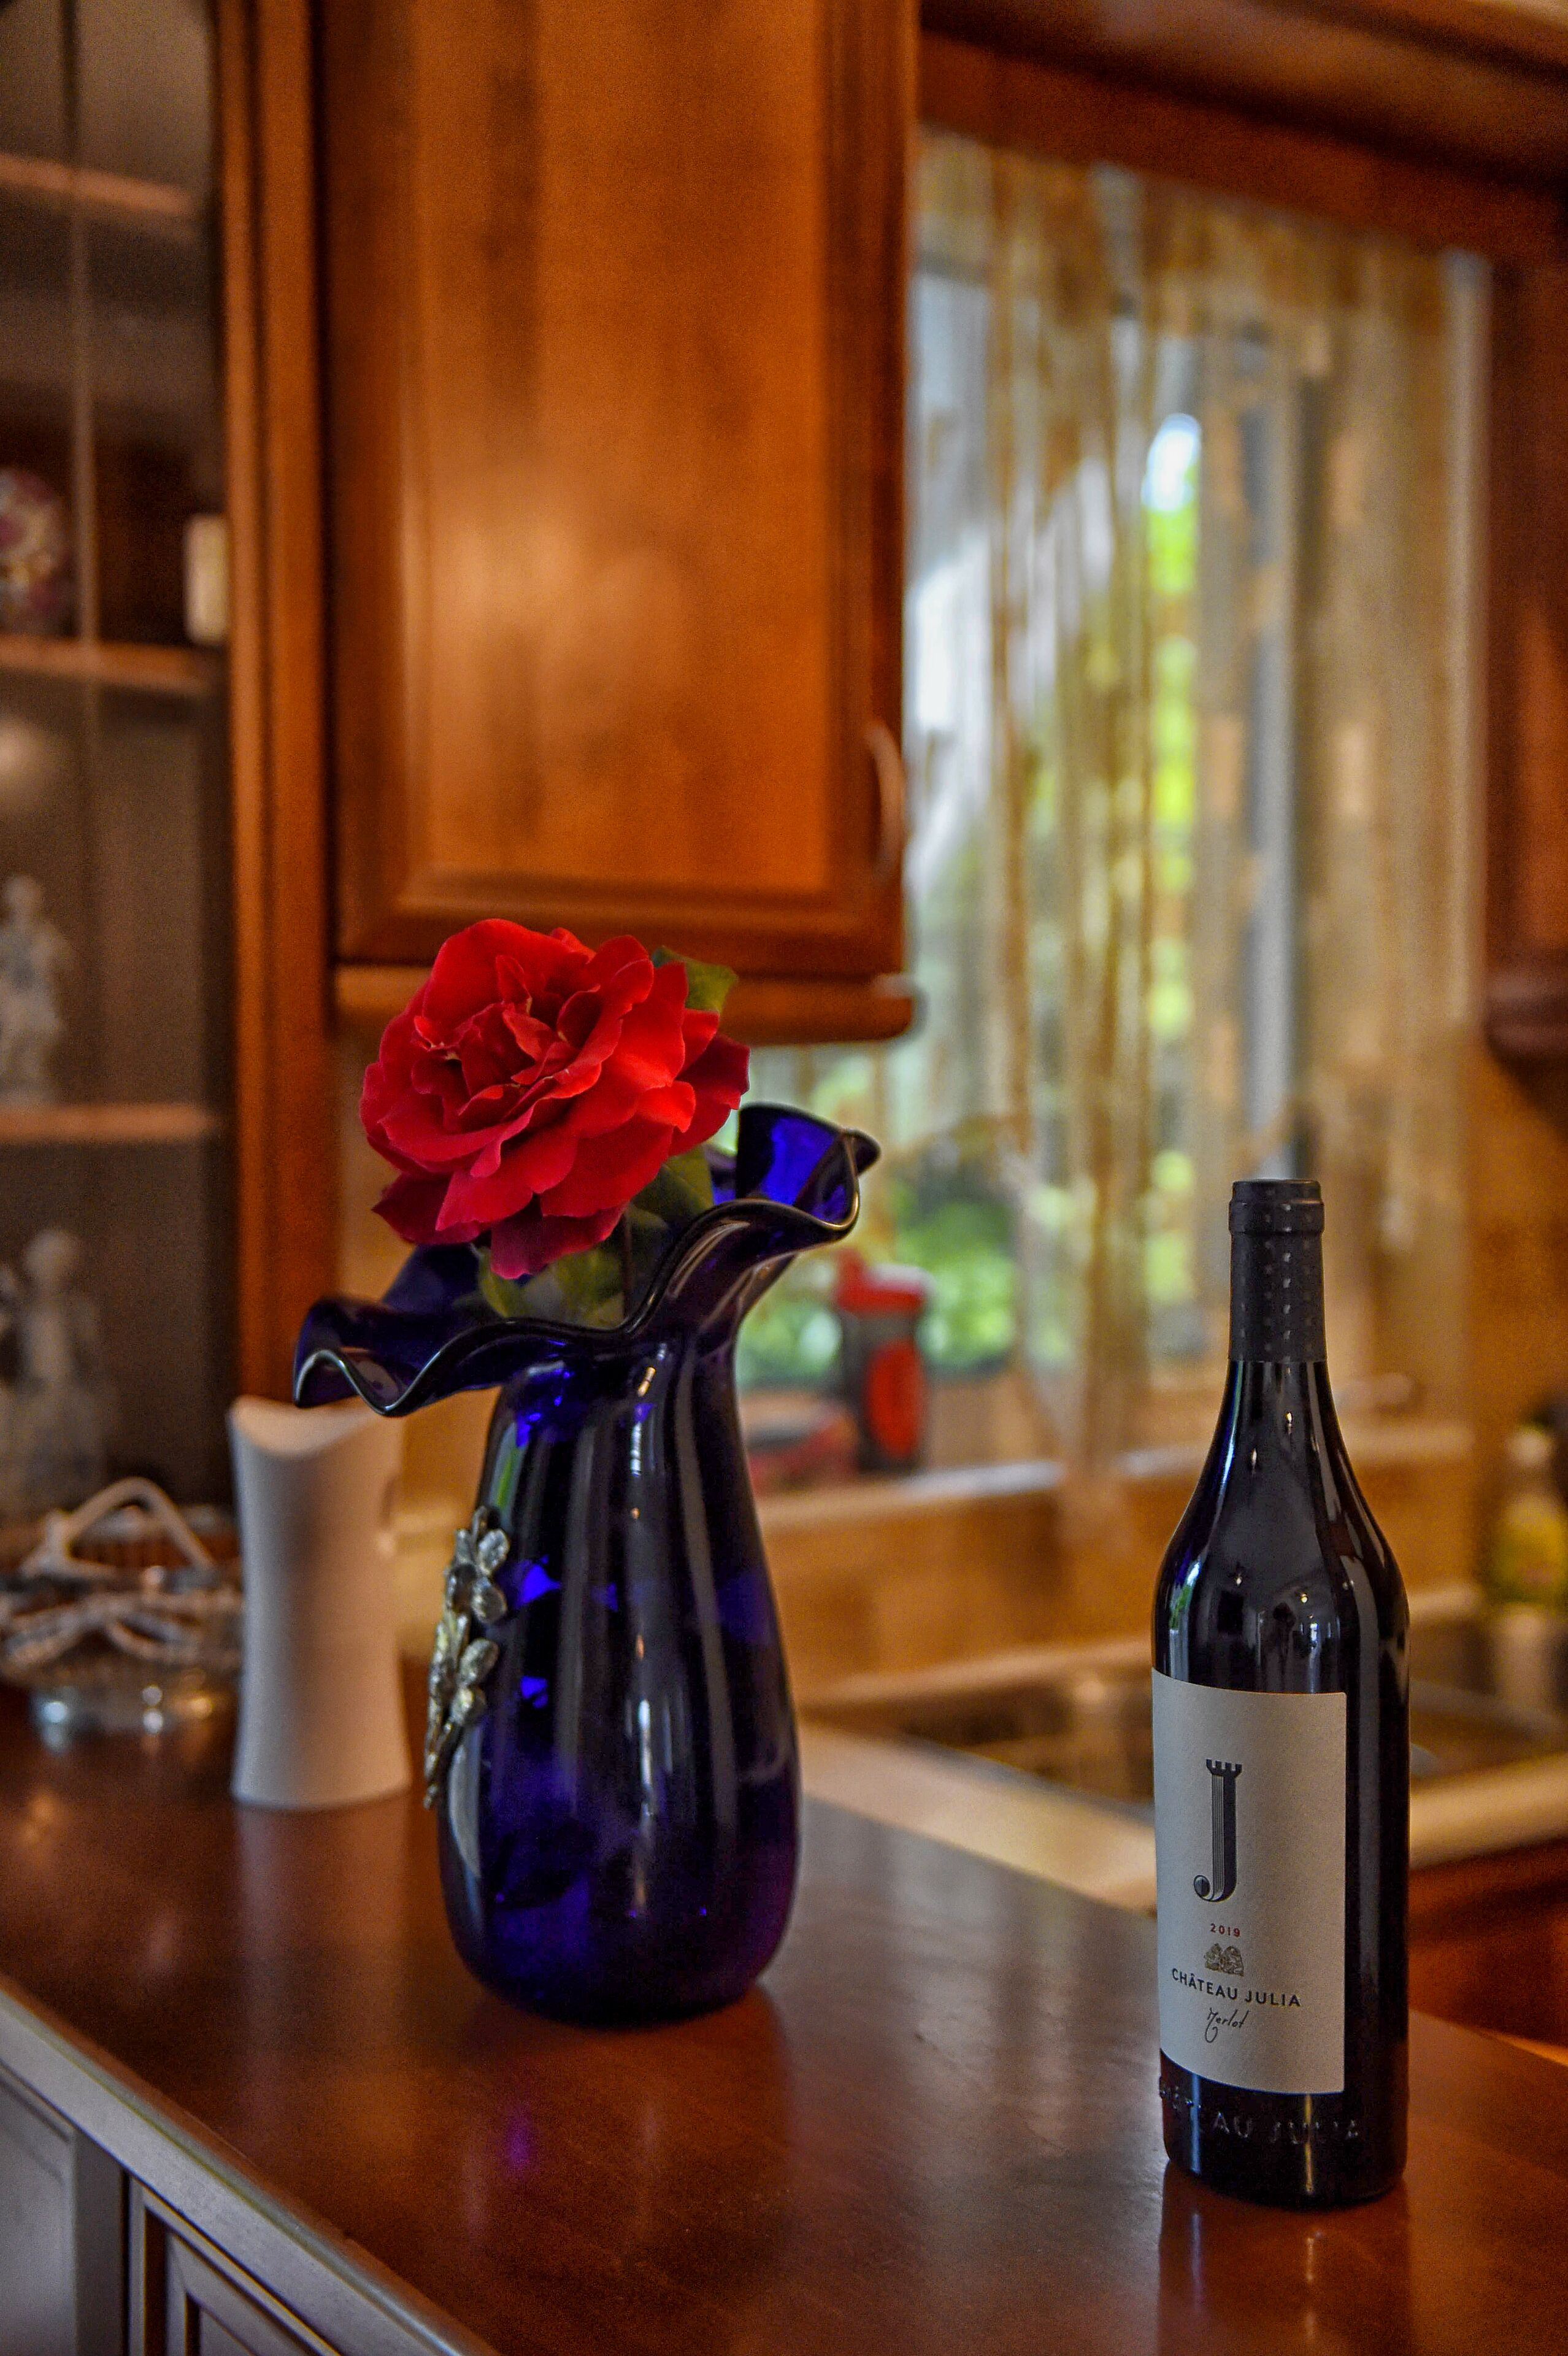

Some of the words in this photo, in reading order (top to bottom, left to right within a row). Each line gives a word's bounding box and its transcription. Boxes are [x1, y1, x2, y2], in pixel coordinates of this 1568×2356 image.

[1193, 1758, 1243, 1902] J
[1210, 1923, 1240, 1938] 2019
[1171, 1968, 1238, 2000] CHÂTEAU
[1244, 1990, 1302, 2008] JULIA
[1205, 2007, 1250, 2044] Merlot
